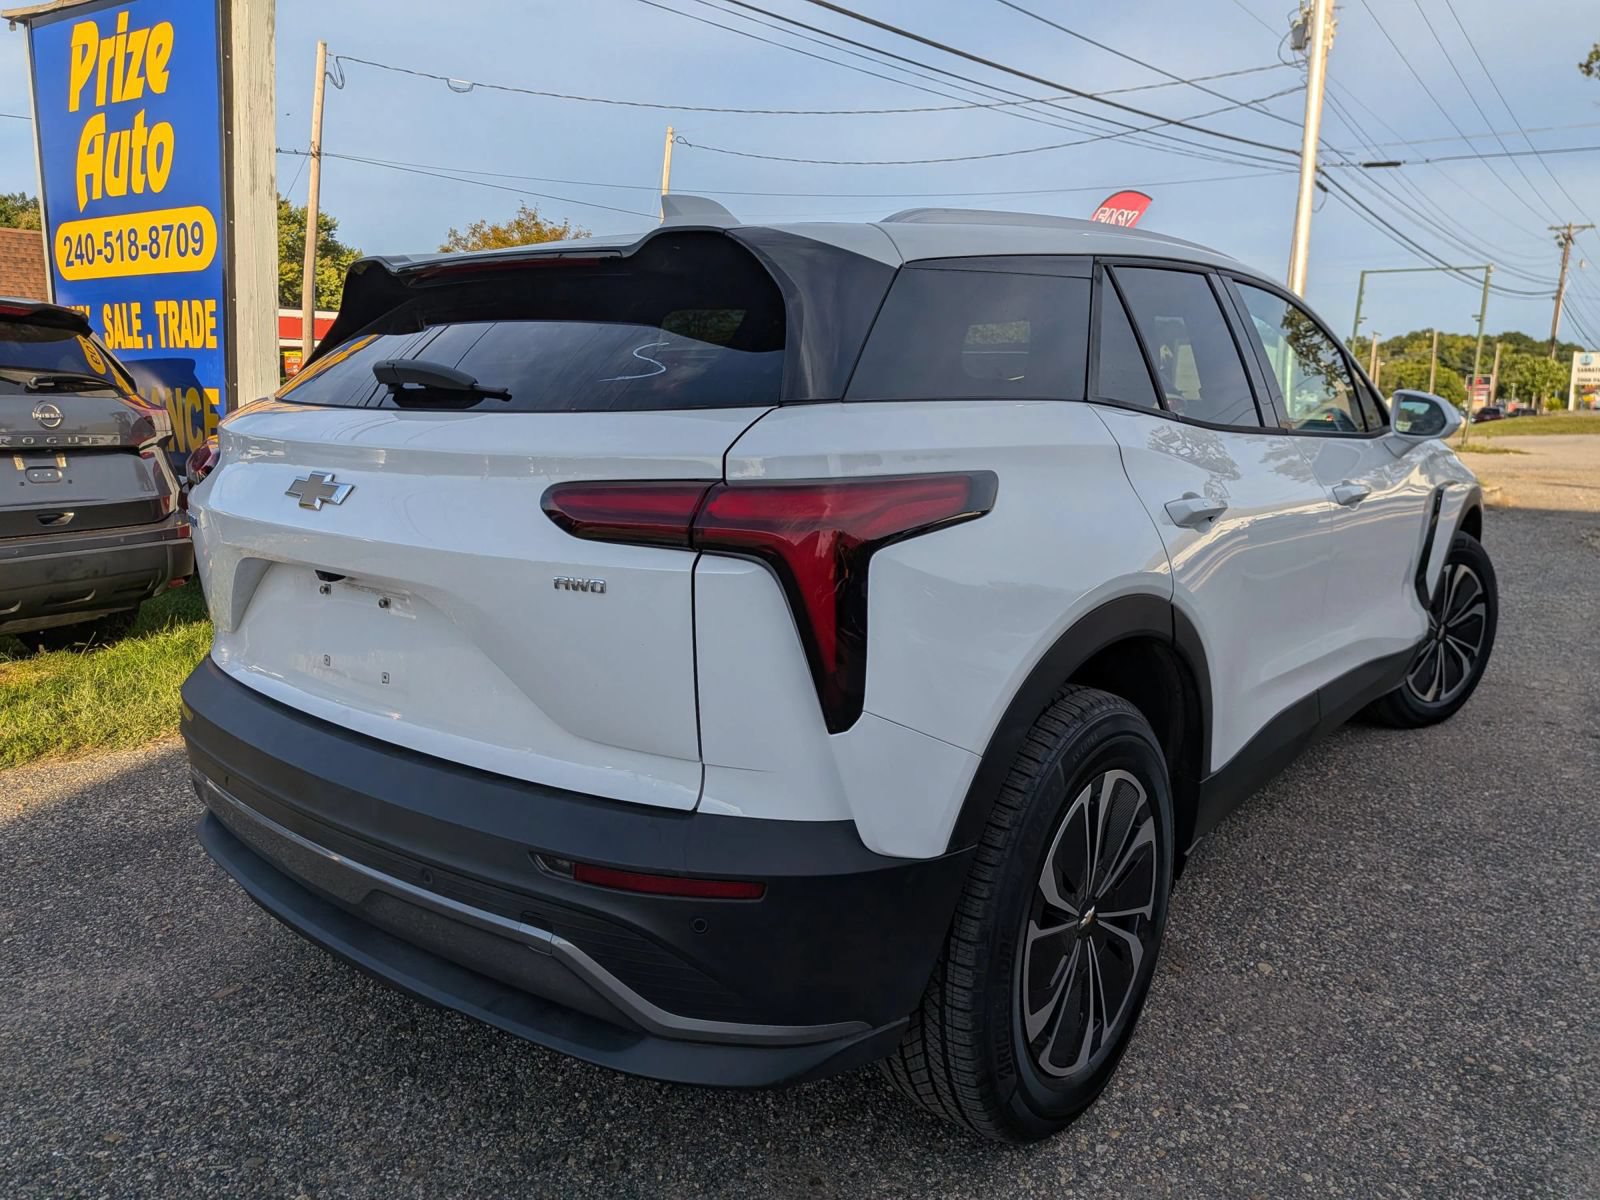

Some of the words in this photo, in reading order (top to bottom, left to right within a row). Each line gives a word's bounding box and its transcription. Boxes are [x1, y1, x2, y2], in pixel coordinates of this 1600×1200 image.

[69, 10, 174, 112] Prize
[76, 109, 175, 213] Auto
[63, 220, 204, 268] 240-518-8709
[154, 299, 218, 349] TRADE
[553, 576, 607, 594] AWD
